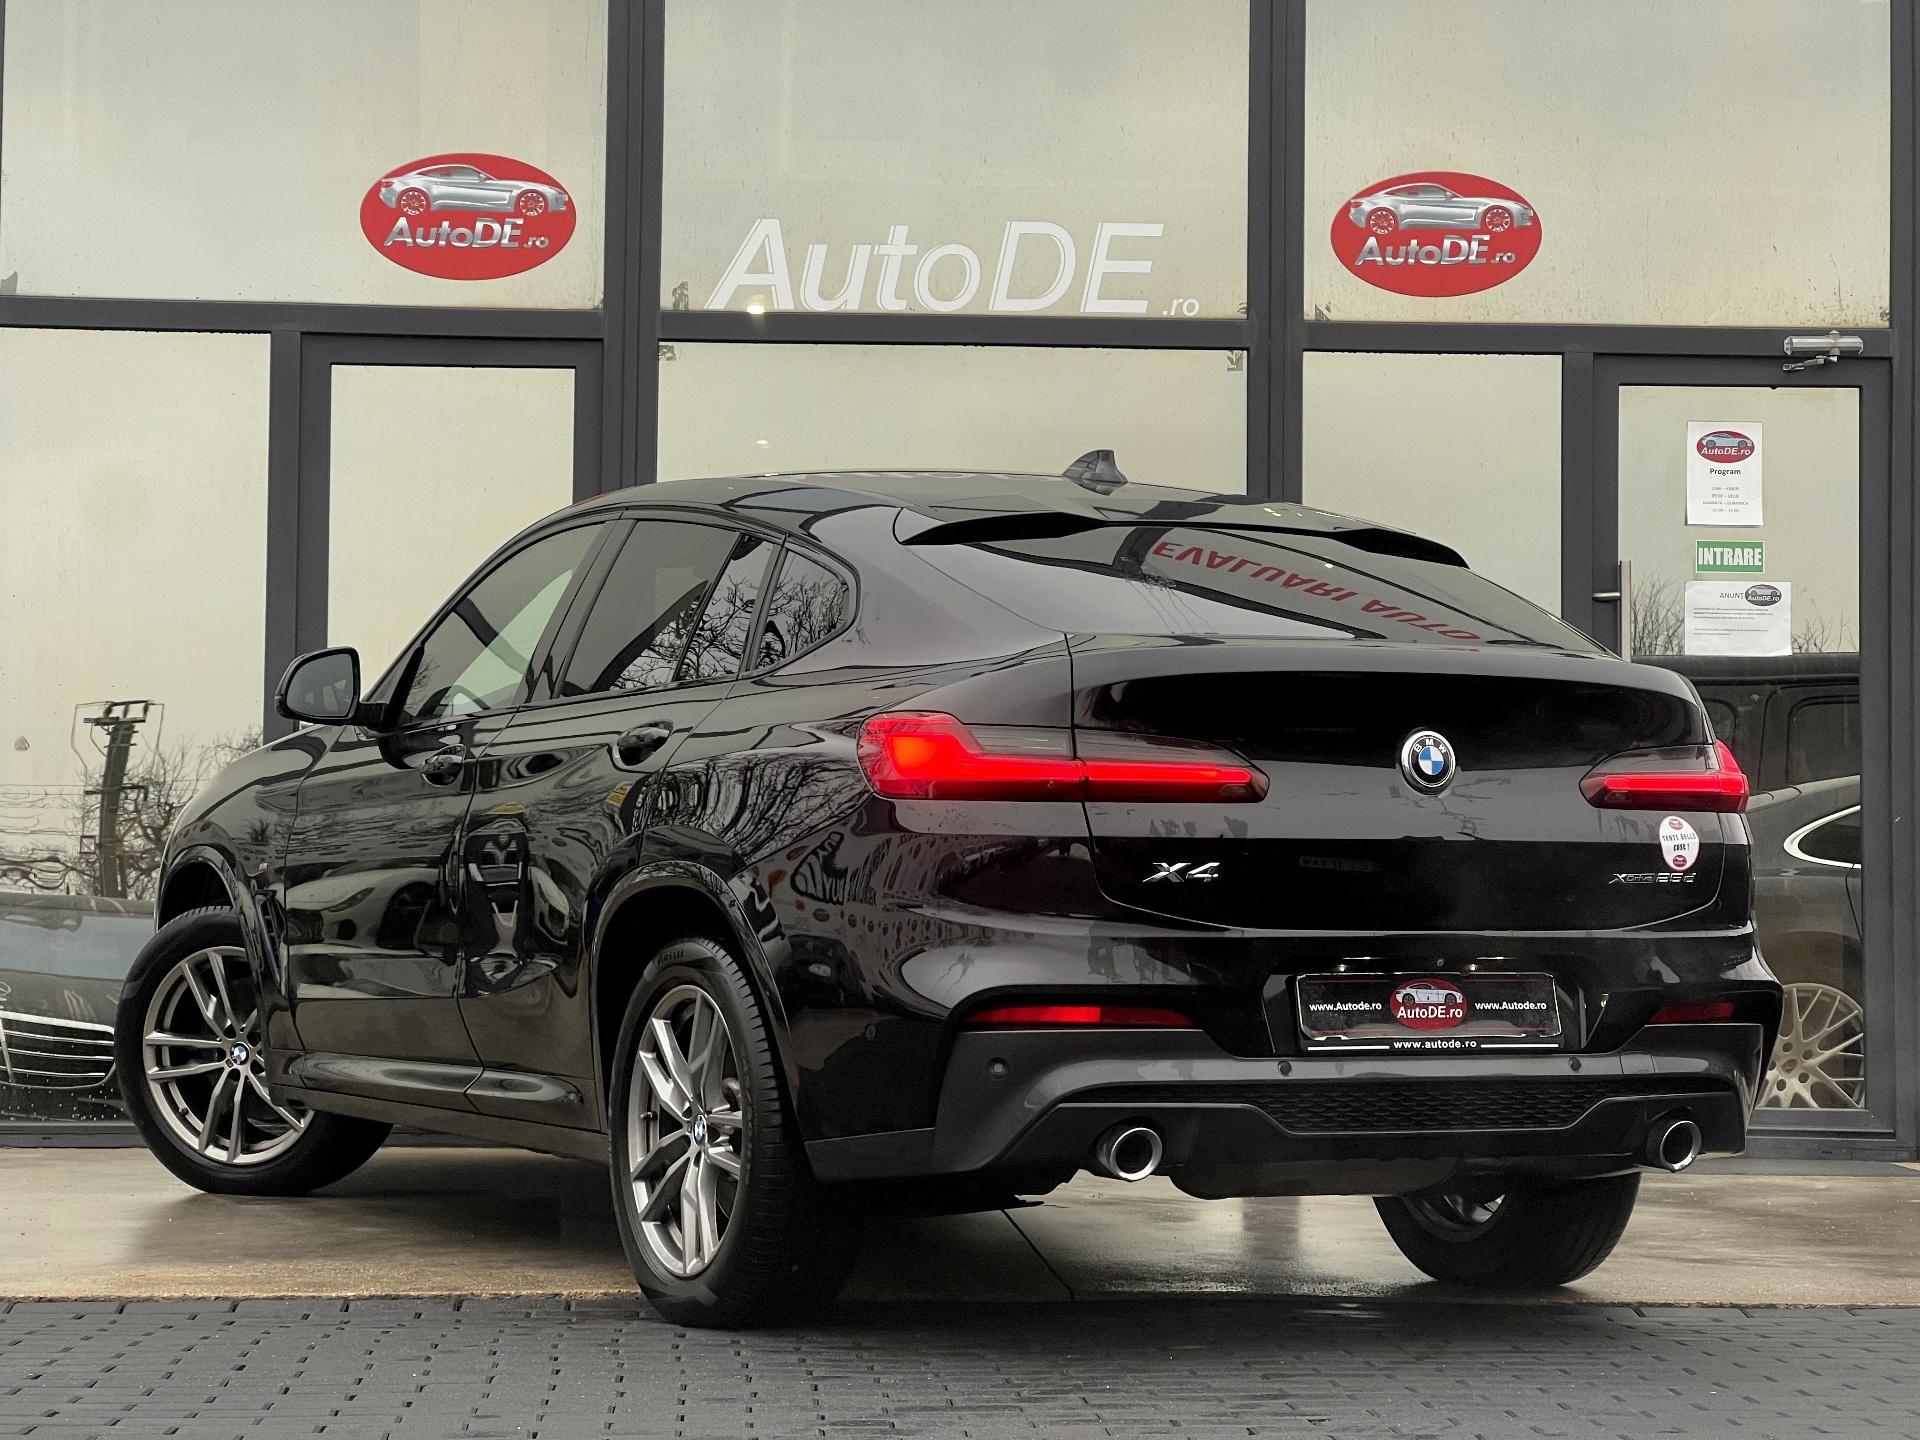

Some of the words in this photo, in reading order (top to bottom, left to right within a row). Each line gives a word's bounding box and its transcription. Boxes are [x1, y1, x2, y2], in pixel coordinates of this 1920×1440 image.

[1700, 447, 1751, 455] AutoDE.ro
[1709, 468, 1741, 476] Program
[1698, 547, 1762, 566] INTRARE
[1413, 738, 1447, 753] BMW
[1661, 834, 1680, 842] TANTE
[1680, 832, 1697, 840] BELLE
[1142, 862, 1221, 883] X4
[1309, 1001, 1382, 1012] www.Autode.ro
[1396, 1005, 1463, 1020] AutoDE.ro
[1475, 1000, 1547, 1010] www.Autode.ro
[1393, 1039, 1477, 1050] www.autode.ro
